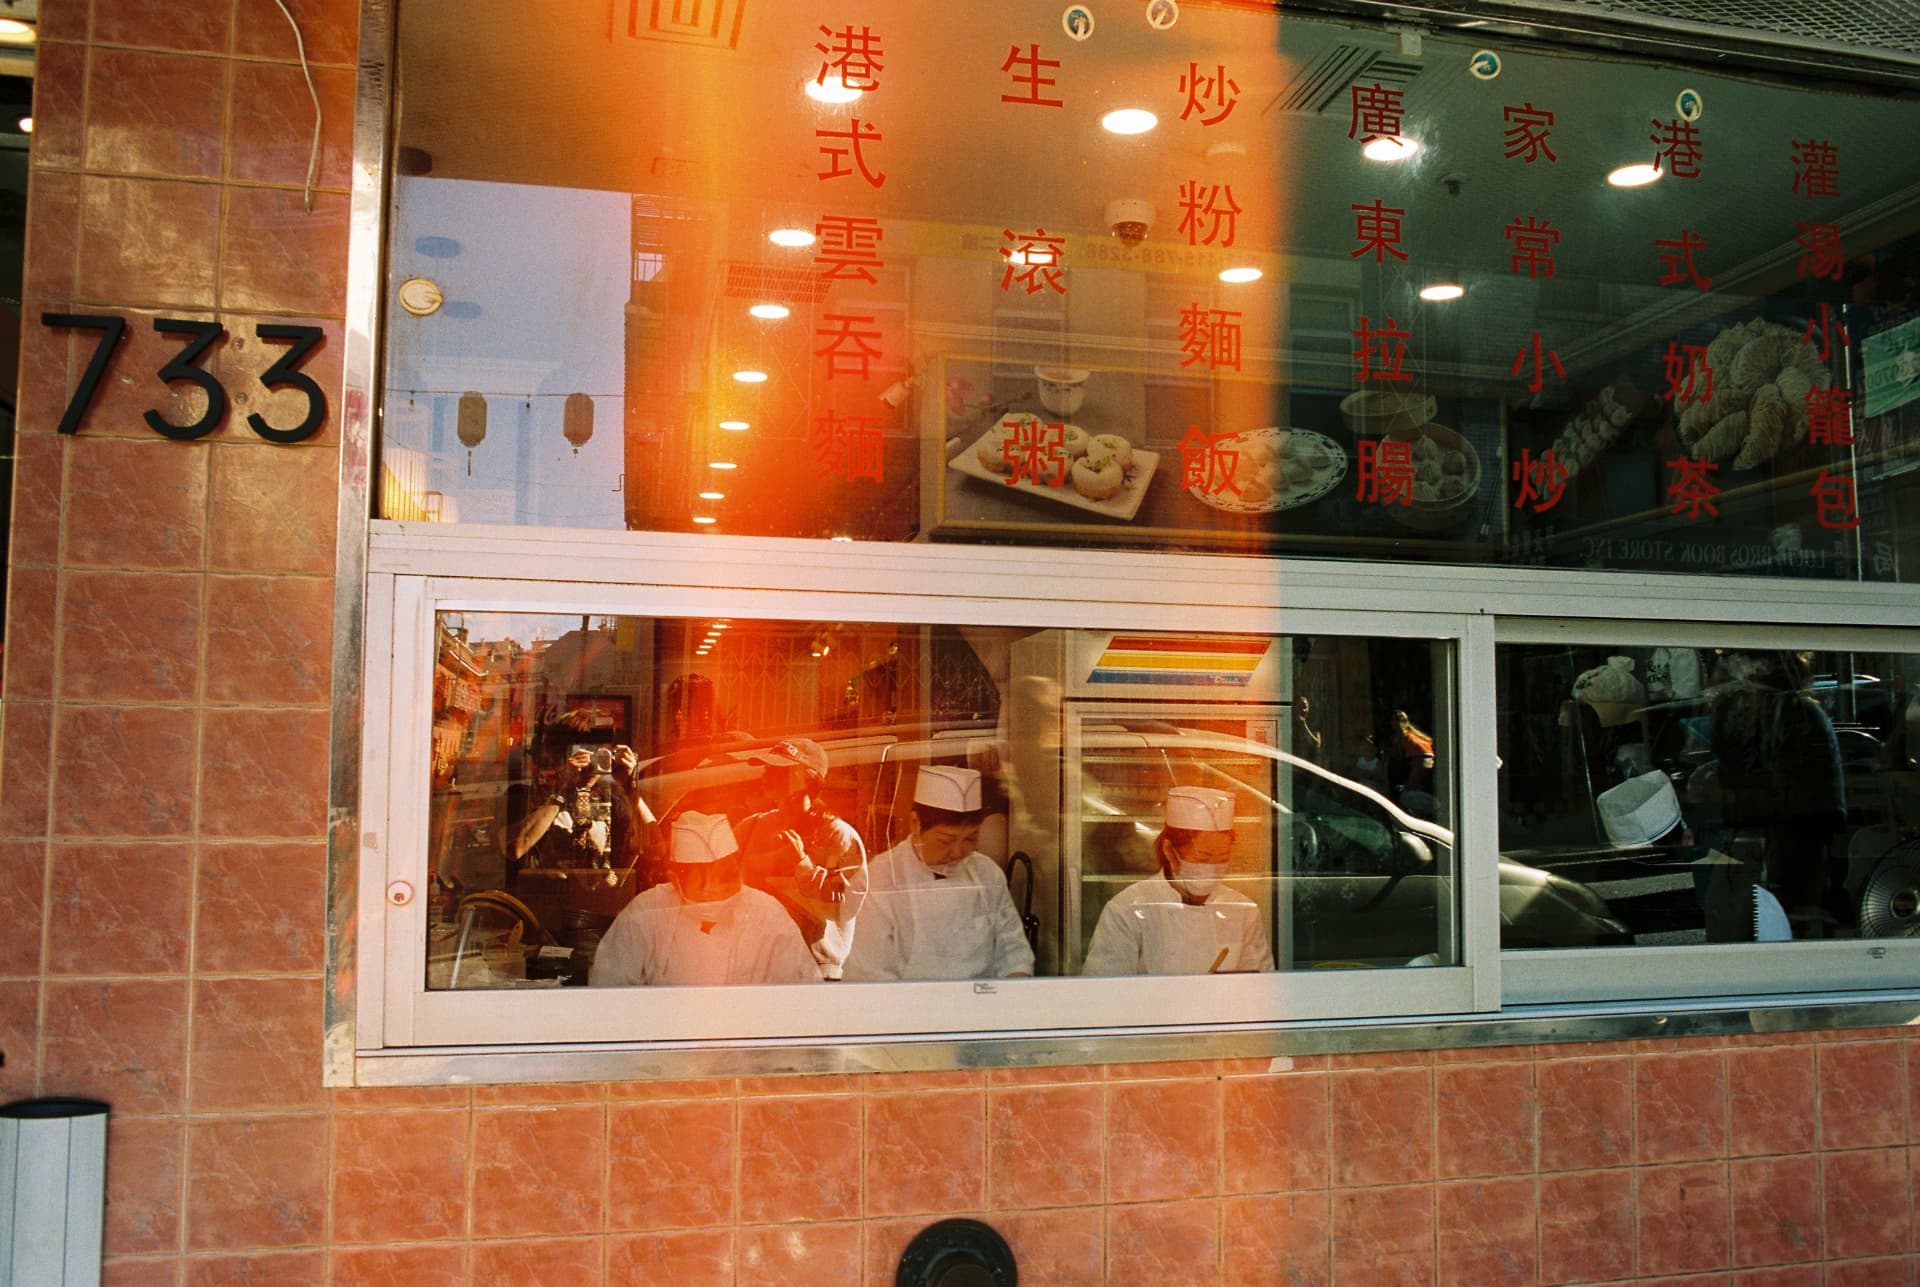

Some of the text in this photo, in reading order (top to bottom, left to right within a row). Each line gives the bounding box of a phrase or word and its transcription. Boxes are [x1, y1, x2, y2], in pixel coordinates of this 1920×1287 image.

[41, 311, 327, 443] 733
[813, 24, 886, 483] 港式雲吞麵
[1000, 43, 1067, 488] 生滾粥
[1177, 62, 1243, 497] 炒粉麵飯
[1348, 83, 1417, 507] 廣東拉腸
[1502, 102, 1569, 513] 家常小炒
[1649, 118, 1721, 520] 港式奶茶
[1790, 138, 1861, 530] 灌湯小籠包
